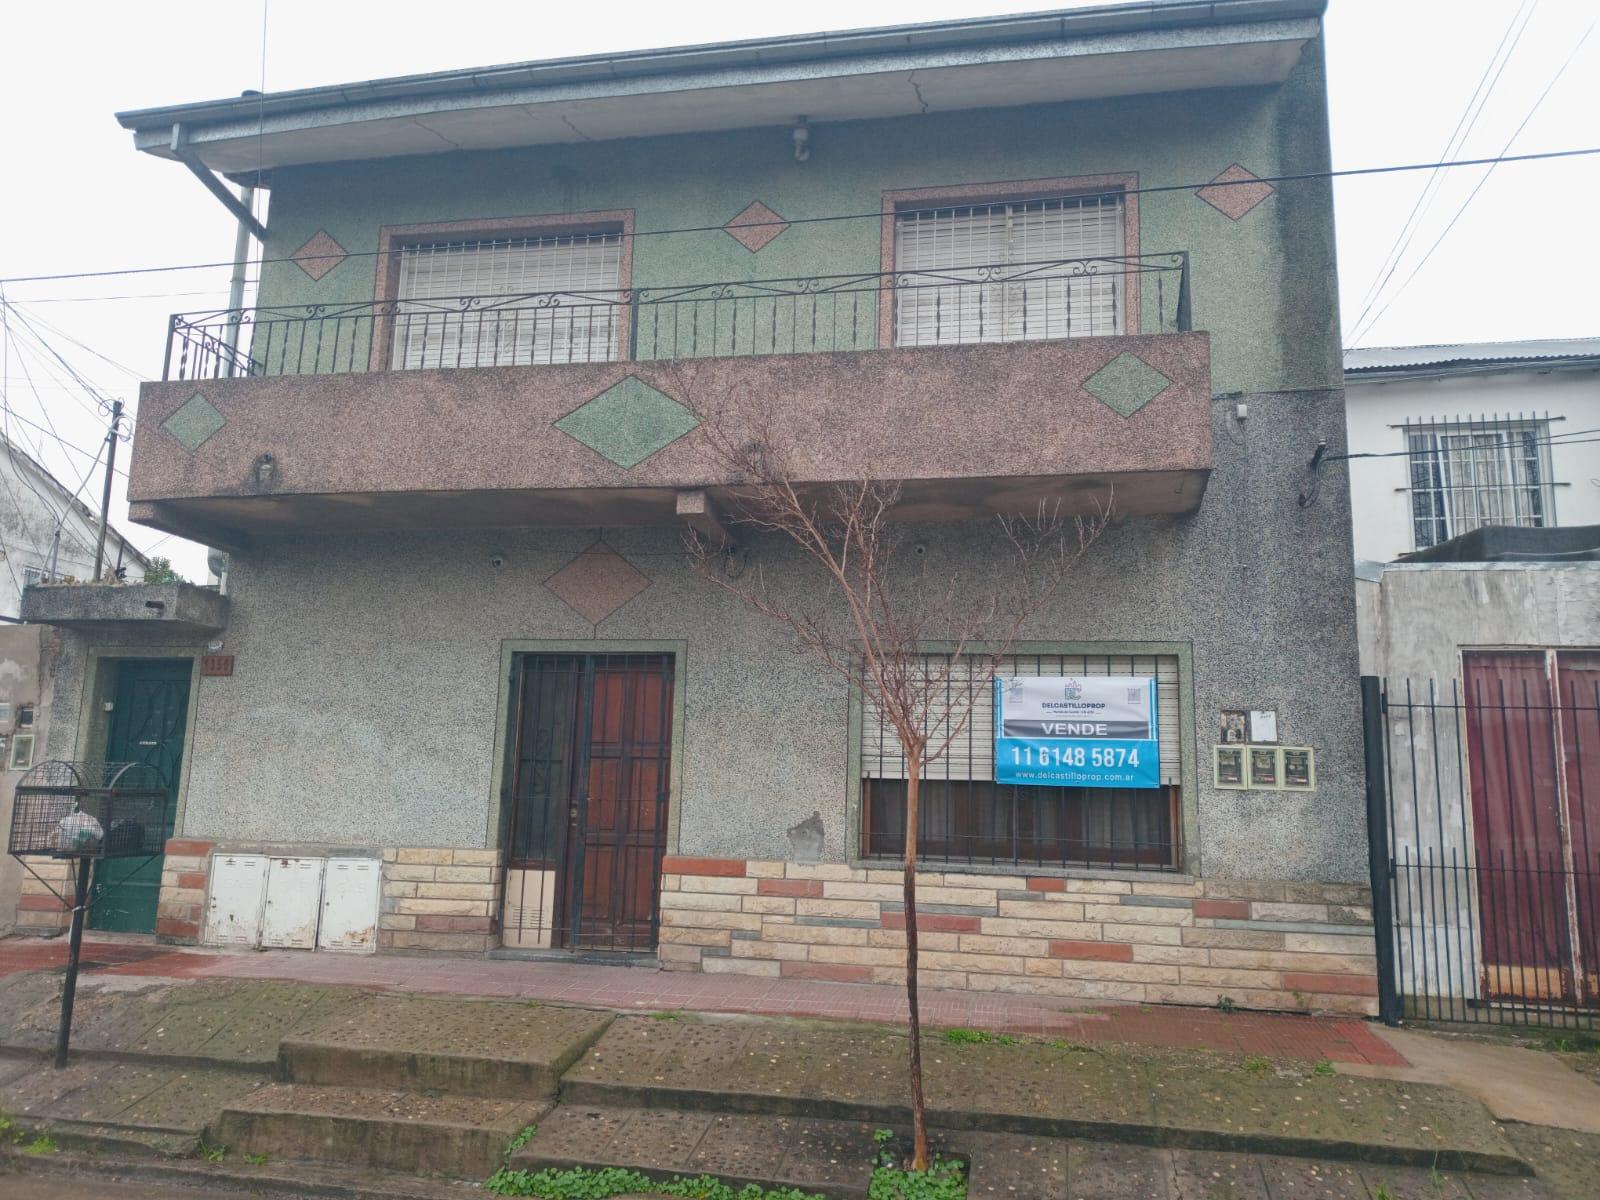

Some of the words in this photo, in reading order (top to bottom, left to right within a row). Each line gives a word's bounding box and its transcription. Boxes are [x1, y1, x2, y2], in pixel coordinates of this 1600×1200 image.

[1041, 723, 1108, 736] VENDE
[1011, 747, 1032, 766] 11
[1039, 747, 1086, 767] 6148
[1091, 747, 1140, 768] 5874
[1015, 770, 1134, 782] www.delcastilloprop.com.ar
